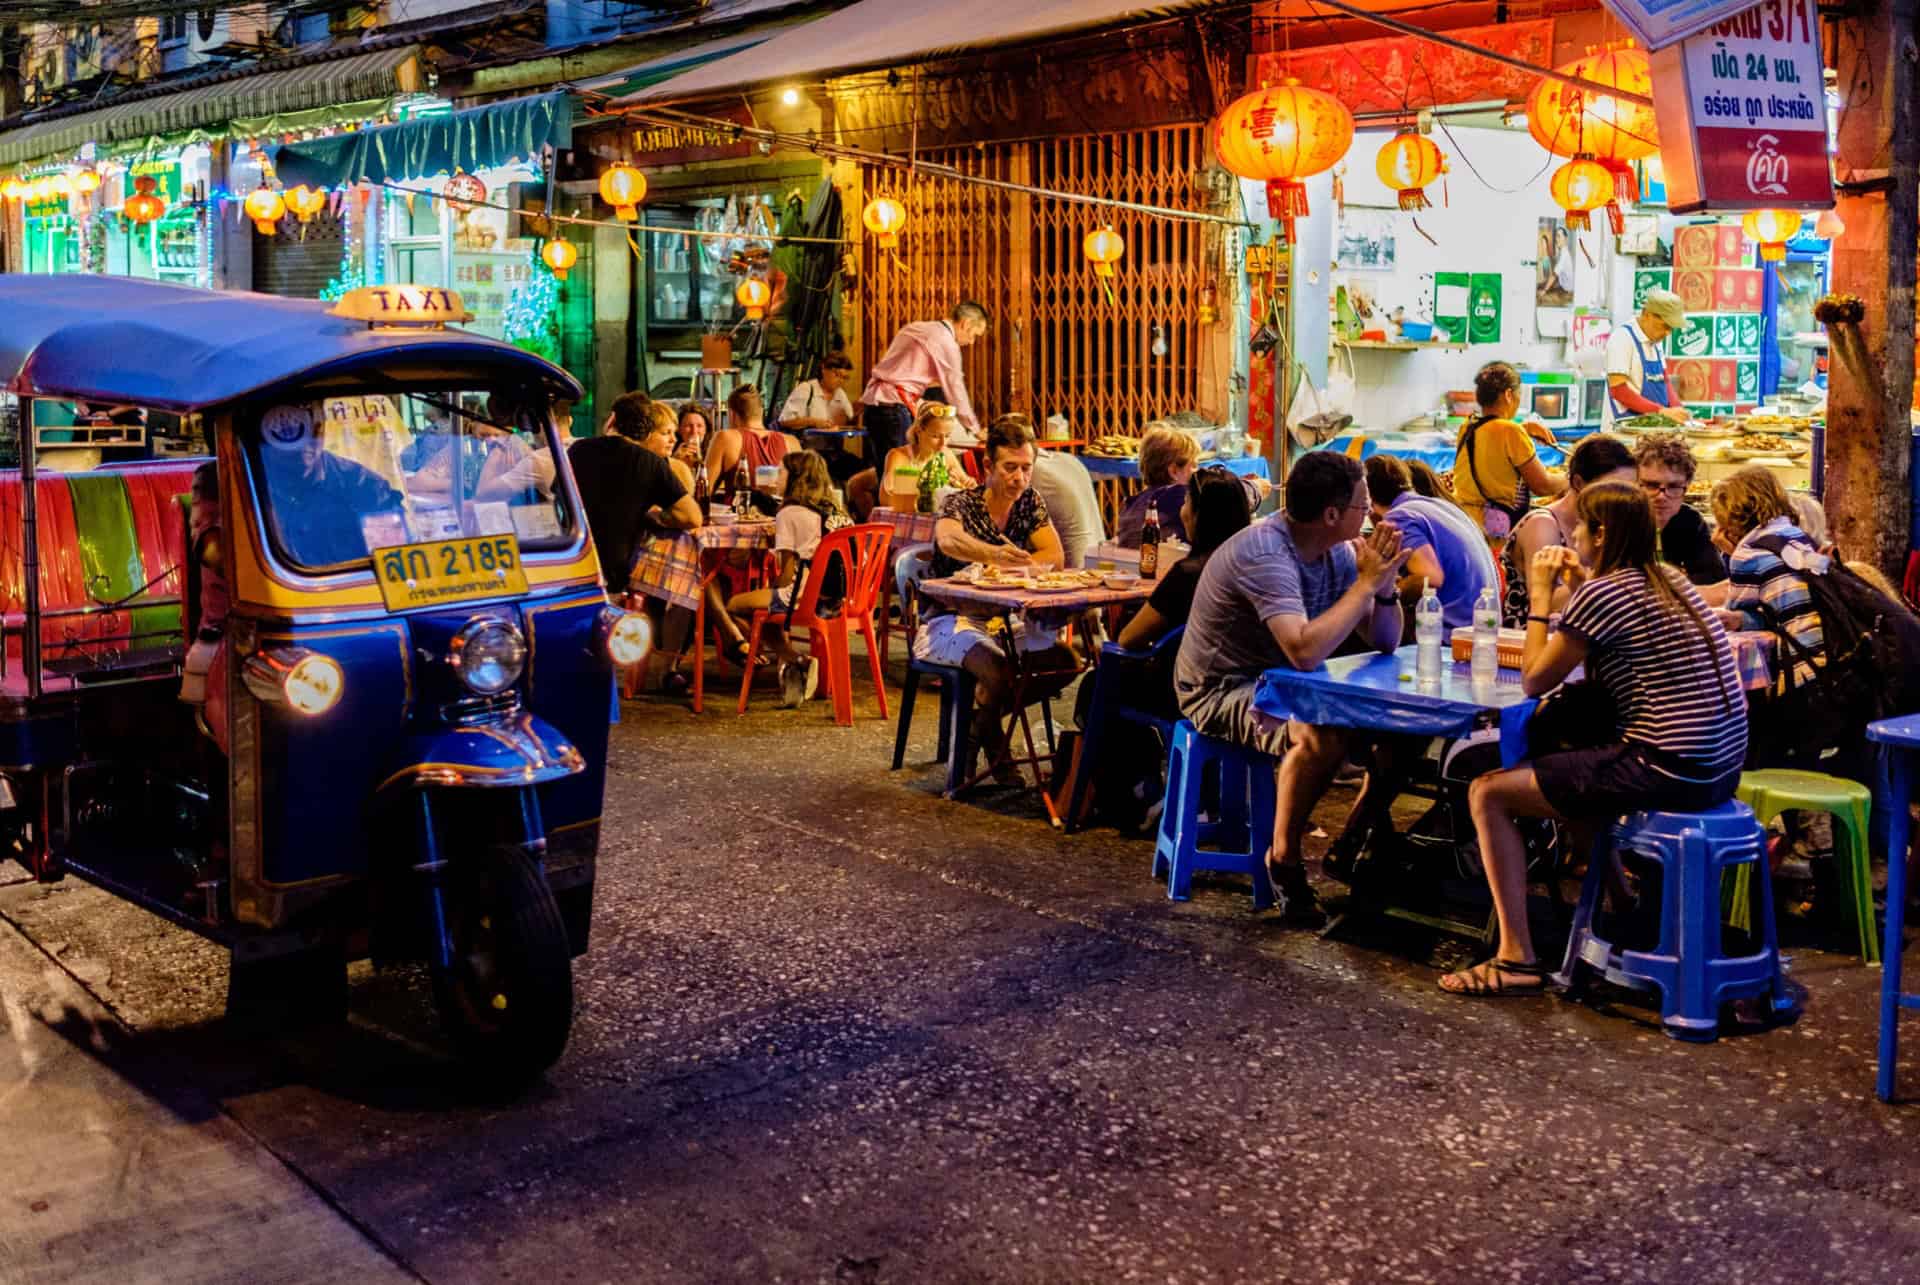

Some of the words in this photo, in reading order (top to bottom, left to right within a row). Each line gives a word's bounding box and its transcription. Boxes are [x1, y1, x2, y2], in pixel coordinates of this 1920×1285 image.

[1711, 41, 1740, 79] เปิด
[1745, 53, 1768, 81] 24
[1773, 58, 1801, 83] ชม.
[1704, 89, 1741, 117] อร่อย
[1745, 97, 1764, 125] ถูก
[1768, 93, 1815, 120] ประหยัด
[371, 290, 453, 311] TAXI
[383, 548, 431, 583] สก
[439, 539, 514, 576] 2185
